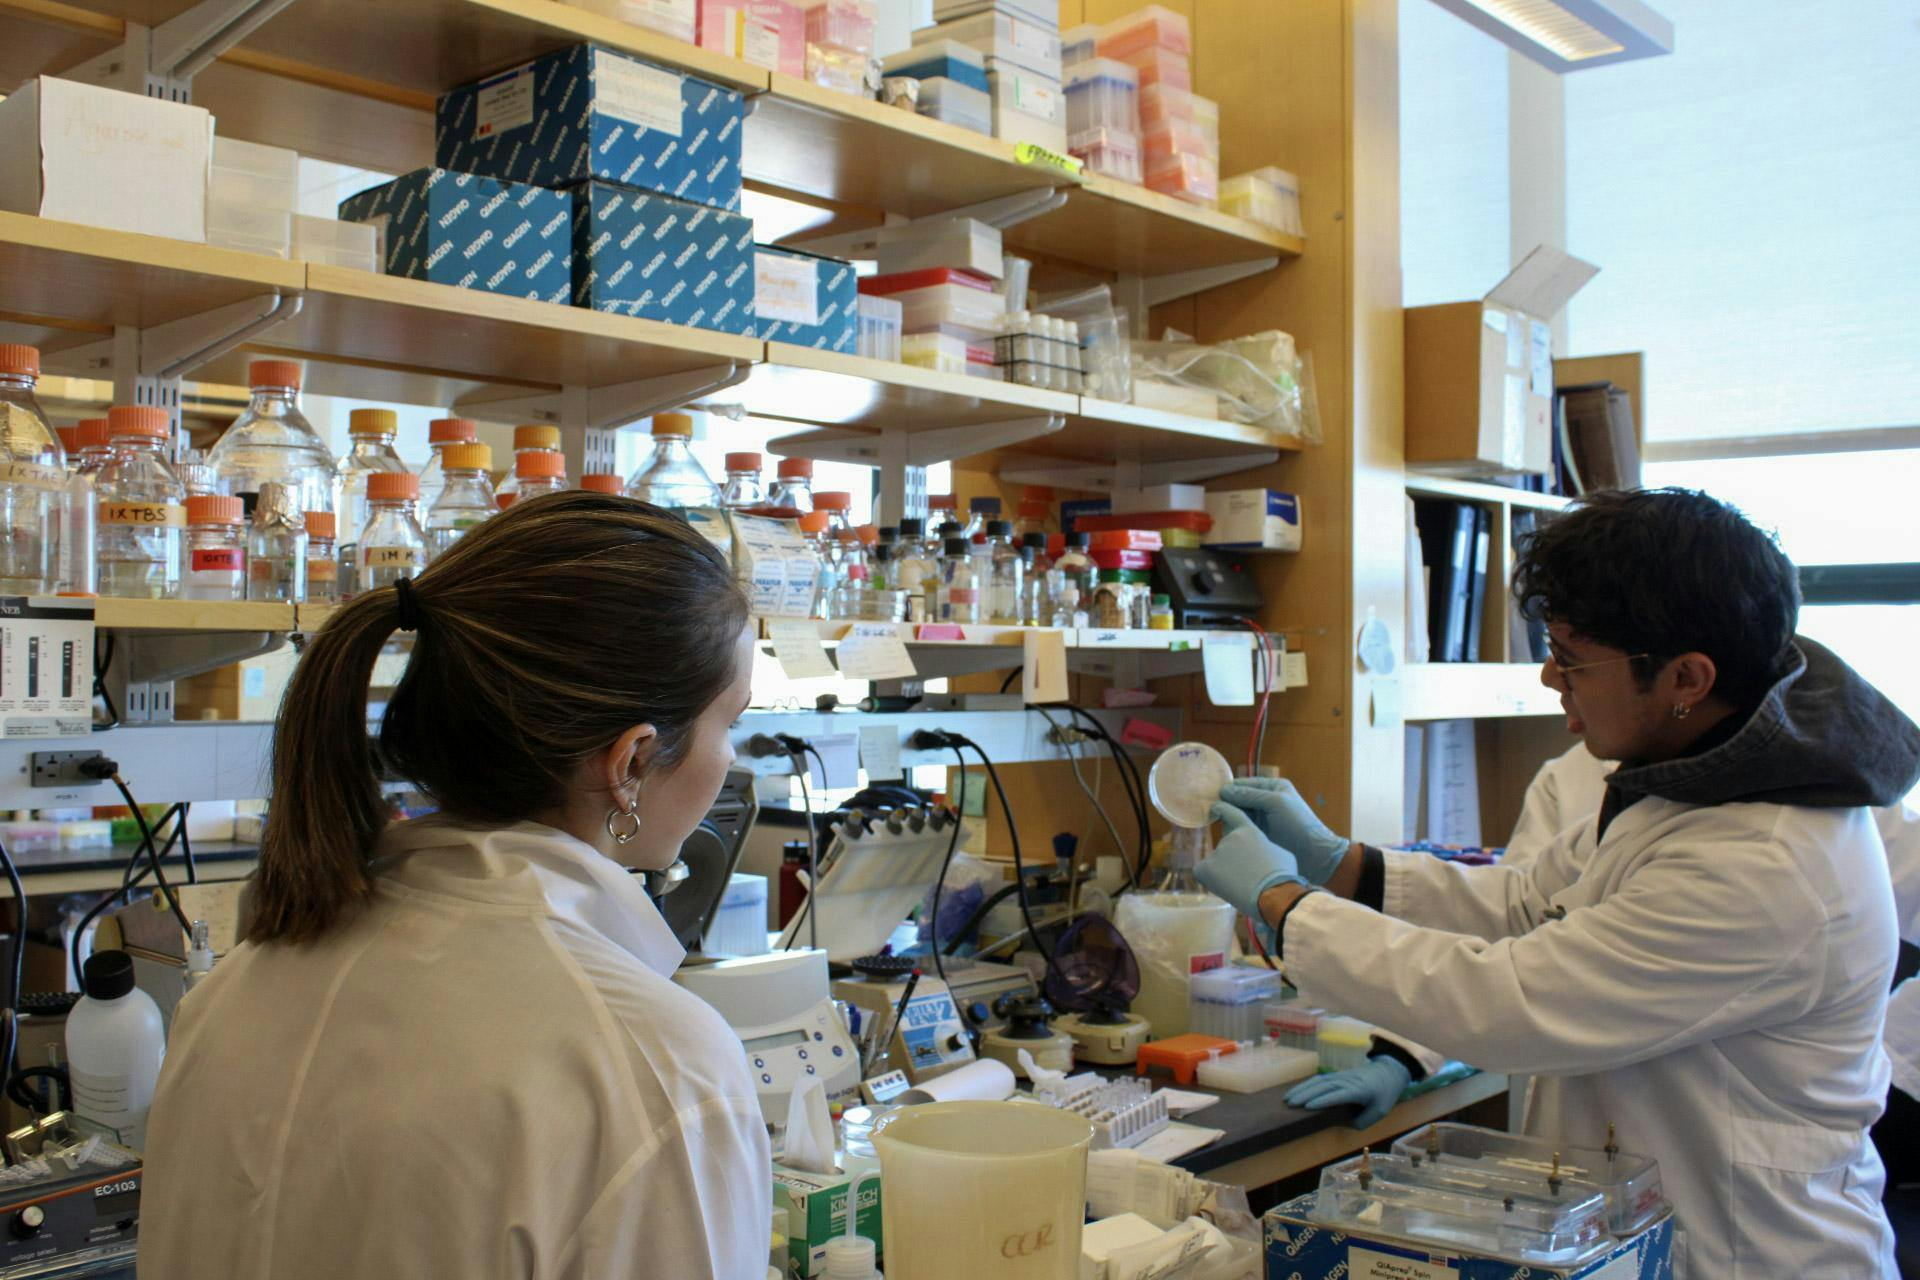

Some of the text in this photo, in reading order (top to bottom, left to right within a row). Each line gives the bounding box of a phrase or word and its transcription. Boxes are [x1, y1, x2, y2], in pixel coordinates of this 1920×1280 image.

[599, 126, 624, 154] QIAGEN
[620, 154, 645, 183] QIAGEN
[438, 199, 469, 229] QIAGEN
[480, 190, 510, 218] QIAGEN
[598, 194, 623, 220] QIAGEN
[503, 219, 532, 248] QIAGEN
[540, 210, 568, 239] QIAGEN
[620, 223, 645, 250] QIAGEN
[653, 214, 677, 241] QIAGEN
[424, 239, 454, 270] QIAGEN
[463, 229, 493, 259] QIAGEN
[674, 242, 698, 269] QIAGEN
[706, 234, 729, 260] QIAGEN
[487, 260, 516, 290] QIAGEN
[525, 250, 554, 279] QIAGEN
[606, 260, 633, 288] QIAGEN
[641, 251, 667, 279] QIAGEN
[661, 280, 686, 307] QIAGEN
[693, 270, 717, 297] QIAGEN
[712, 298, 736, 325] QIAGEN
[132, 508, 167, 522] TBS
[95, 1181, 136, 1197] EC-103
[1414, 1269, 1431, 1280] Spin
